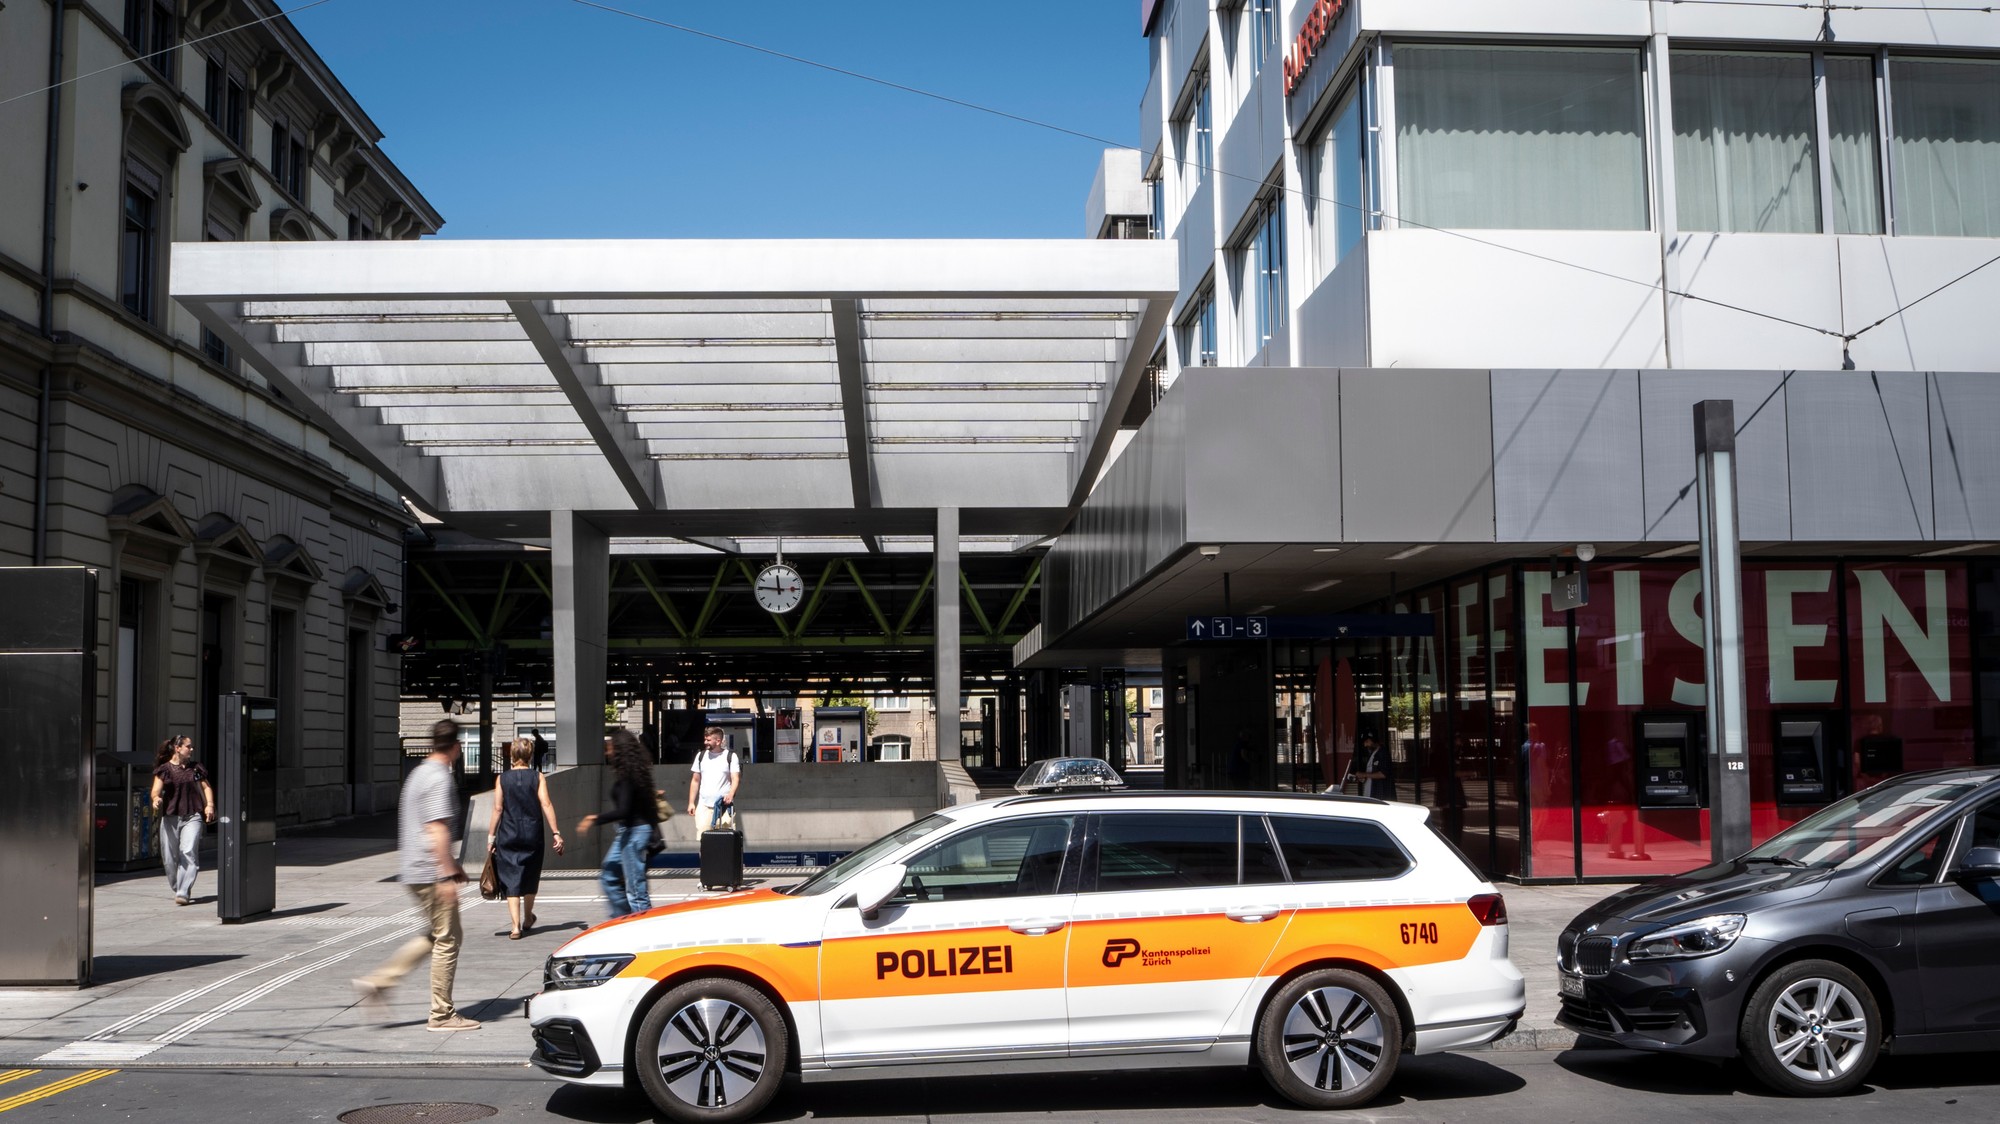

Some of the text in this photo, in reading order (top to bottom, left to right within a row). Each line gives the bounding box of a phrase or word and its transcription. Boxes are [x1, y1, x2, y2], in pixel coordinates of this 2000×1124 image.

[1218, 622, 1225, 635] 1
[1252, 622, 1262, 635] 3
[1727, 761, 1744, 771] 12B
[1399, 922, 1439, 945] 6740
[1141, 947, 1211, 958] Kantonspolizei
[877, 945, 1012, 980] POLIZEI
[1142, 957, 1171, 967] Zürich
